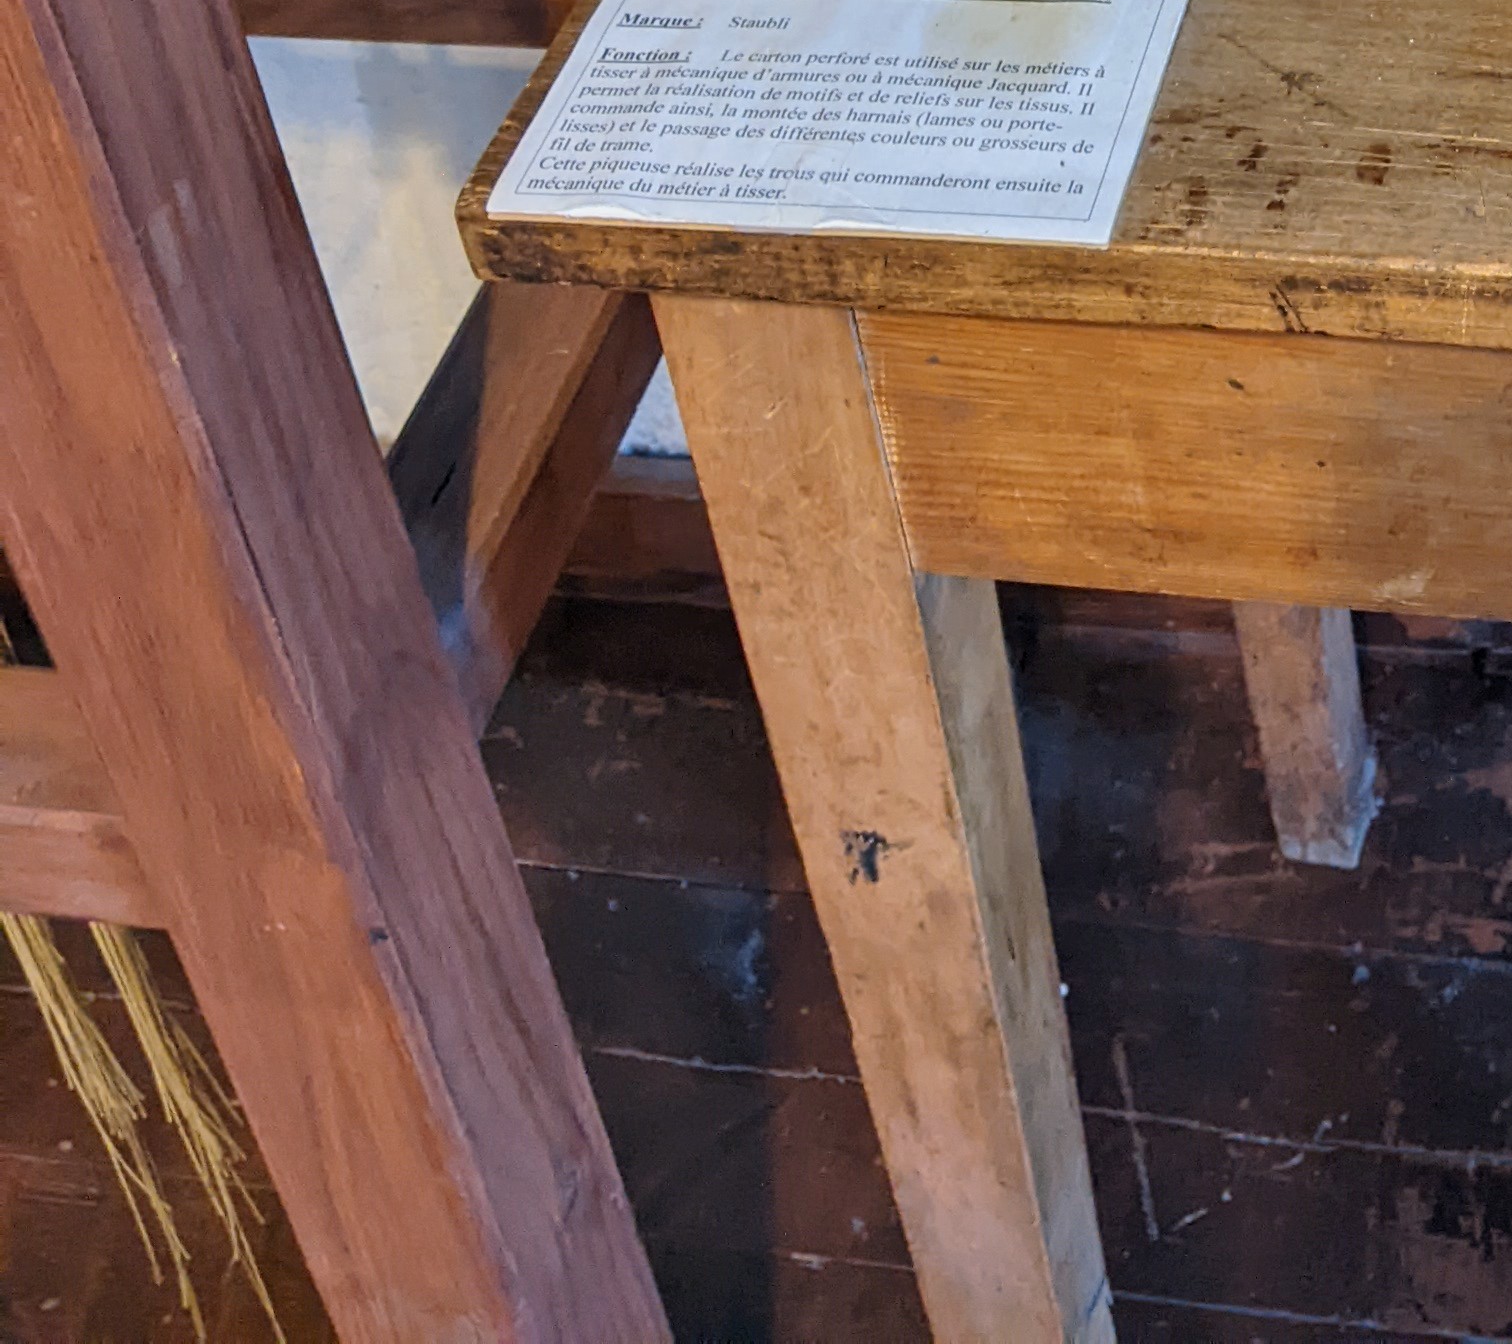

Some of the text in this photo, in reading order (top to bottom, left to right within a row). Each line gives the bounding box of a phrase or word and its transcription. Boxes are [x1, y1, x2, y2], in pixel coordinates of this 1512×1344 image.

[728, 15, 791, 30] Staubli
[720, 49, 744, 62] Le
[748, 52, 802, 64] carton
[804, 52, 870, 67] perforé
[874, 55, 900, 67] est
[904, 56, 959, 70] utilisé
[962, 60, 991, 72] sur
[996, 60, 1020, 74] les
[1025, 62, 1090, 78] métiers
[1095, 65, 1106, 79] à
[590, 65, 638, 79] tisser
[640, 66, 650, 79] à
[655, 66, 749, 82] mécanique
[844, 72, 867, 84] ou
[872, 71, 882, 84] à
[887, 72, 983, 91] mécanique
[986, 78, 1071, 96] Jacquard.
[1078, 83, 1093, 97] Il
[577, 83, 1095, 116] permet la réalisation de motifs et de reliefs sur les tissus. Il
[569, 100, 1063, 133] commande ainsi, la montée des harnais (lames ou porte-
[549, 137, 654, 153] fil de trame.
[559, 119, 1095, 155] lisses) et le passage des différentes couleurs ou grosseurs de
[526, 176, 788, 200] mécanique du métier à tisser.
[539, 156, 1084, 195] Cette piqueuse réalise les trous qui commanderont ensuite la
